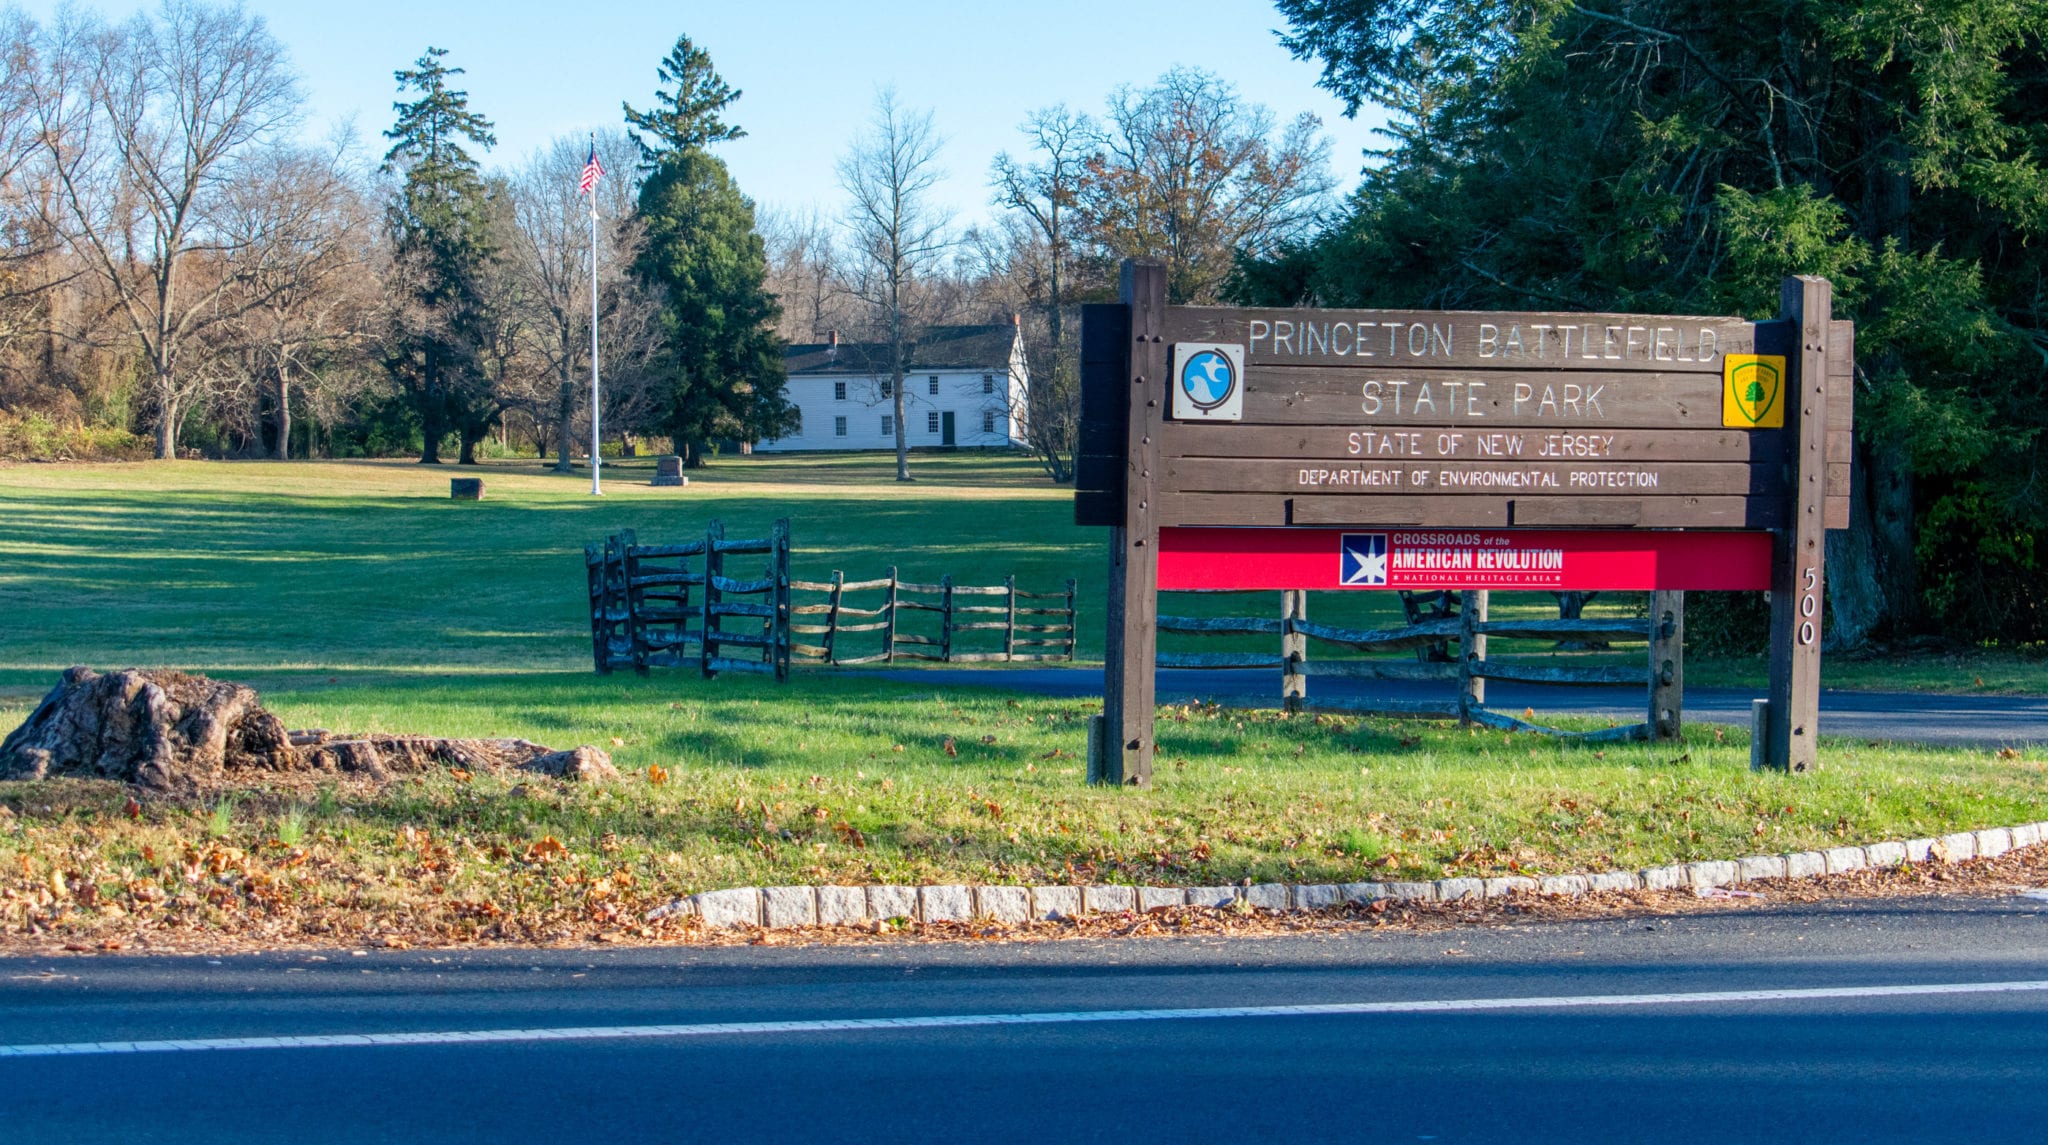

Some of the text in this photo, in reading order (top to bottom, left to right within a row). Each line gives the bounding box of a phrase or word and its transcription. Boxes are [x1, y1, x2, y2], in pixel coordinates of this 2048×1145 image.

[1250, 320, 1717, 362] PRINCETON BATTLEFIELD
[1362, 380, 1605, 418] STATE PARK
[1348, 432, 1614, 456] STATE OF NEW JERSEY
[1299, 469, 1658, 487] DEPARTMENT OF ENVIRONMENTAL PROTECTION
[1393, 533, 1510, 546] CROSSROADS of the
[1392, 547, 1563, 569] AMERICAN REVOLUTION
[1404, 574, 1551, 582] NATIONAL HERITAGE AREA
[1801, 567, 1816, 645] 500
